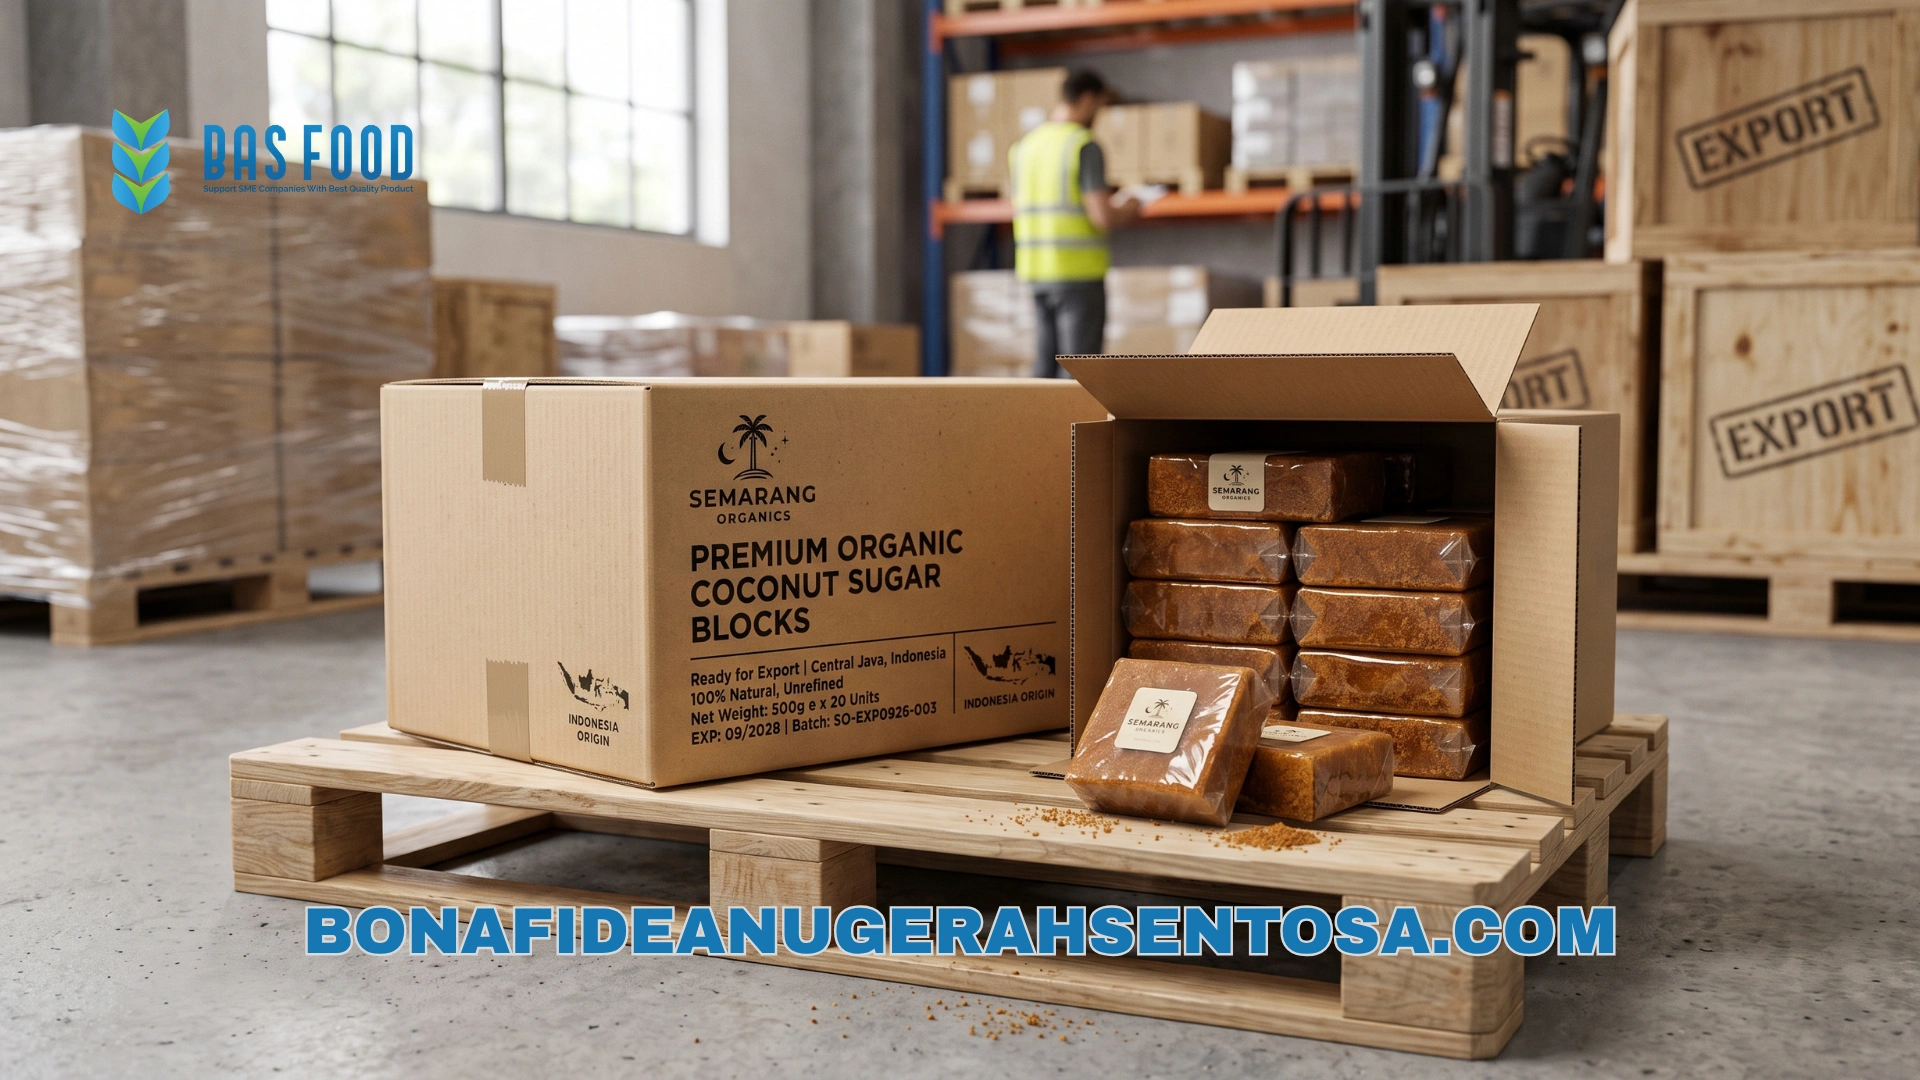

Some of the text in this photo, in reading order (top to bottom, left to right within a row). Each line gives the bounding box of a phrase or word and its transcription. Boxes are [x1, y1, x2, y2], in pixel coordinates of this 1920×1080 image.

[1693, 83, 1859, 174] EXPORT
[1501, 364, 1567, 409] ORT
[1727, 381, 1898, 463] EXPORT
[689, 485, 816, 508] SEMARANG
[1212, 487, 1260, 495] SEMARANG
[716, 510, 791, 525] ORGANICS
[691, 529, 964, 572] PREMIUM ORGANIC
[690, 563, 941, 607] COCONUT SUGAR
[691, 606, 811, 643] BLOCKS
[691, 669, 732, 686] Ready
[735, 667, 754, 682] for
[758, 662, 800, 680] Export
[811, 655, 854, 673] Central
[857, 653, 888, 668] Java,
[891, 646, 947, 665] Indonesia
[691, 675, 844, 706] 100% Natural, Unrefined
[963, 688, 1056, 710] INDONESIA ORIGIN
[568, 713, 619, 733] INDONESIA
[691, 711, 714, 726] Net
[718, 704, 768, 722] Weight:
[771, 700, 805, 716] 500g
[819, 699, 827, 710] x
[830, 695, 846, 708] 20
[850, 691, 880, 706] Units
[691, 730, 721, 745] EXP:
[725, 721, 781, 741] 09/2028
[792, 715, 830, 732] Batch:
[834, 701, 938, 726] SO-EXP0926-003
[1127, 718, 1180, 730] SEMARANG
[577, 730, 610, 747] ORIGIN
